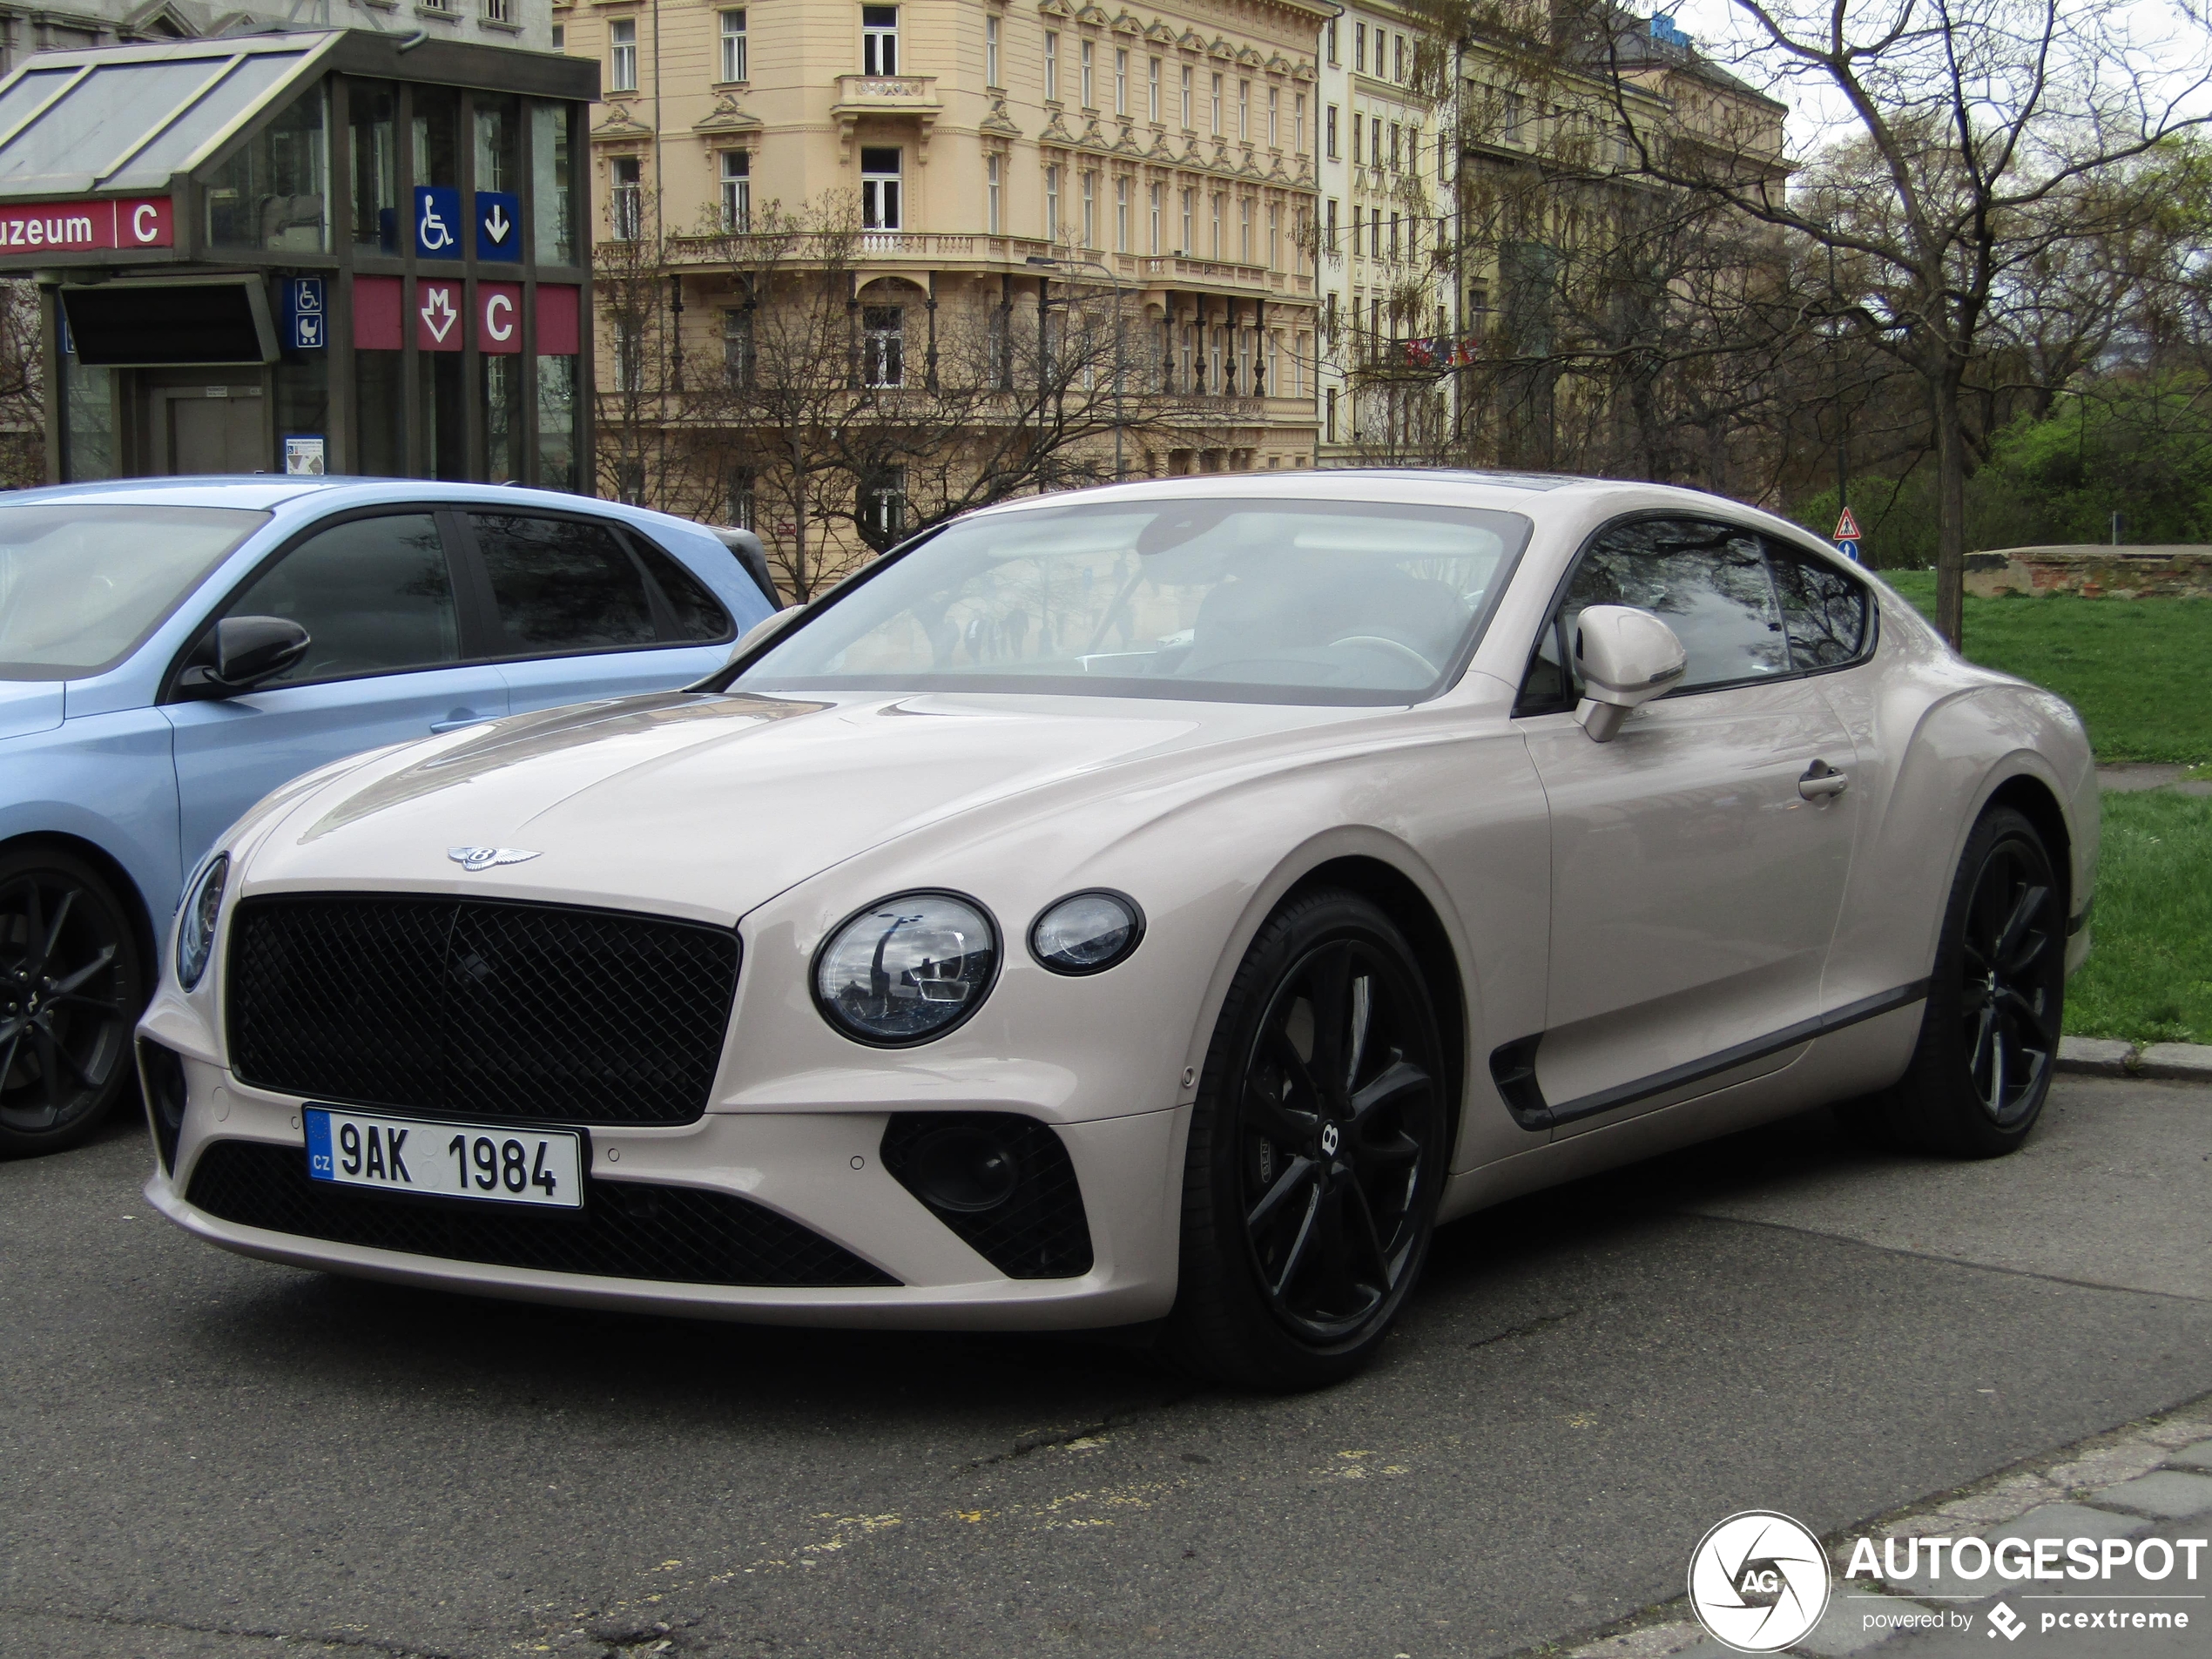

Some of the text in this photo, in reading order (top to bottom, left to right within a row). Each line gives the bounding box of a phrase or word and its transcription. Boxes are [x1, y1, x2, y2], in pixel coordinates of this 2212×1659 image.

[133, 204, 158, 243] C
[486, 293, 513, 341] C
[314, 1154, 331, 1171] CZ
[340, 1122, 557, 1197] 9AK 1984
